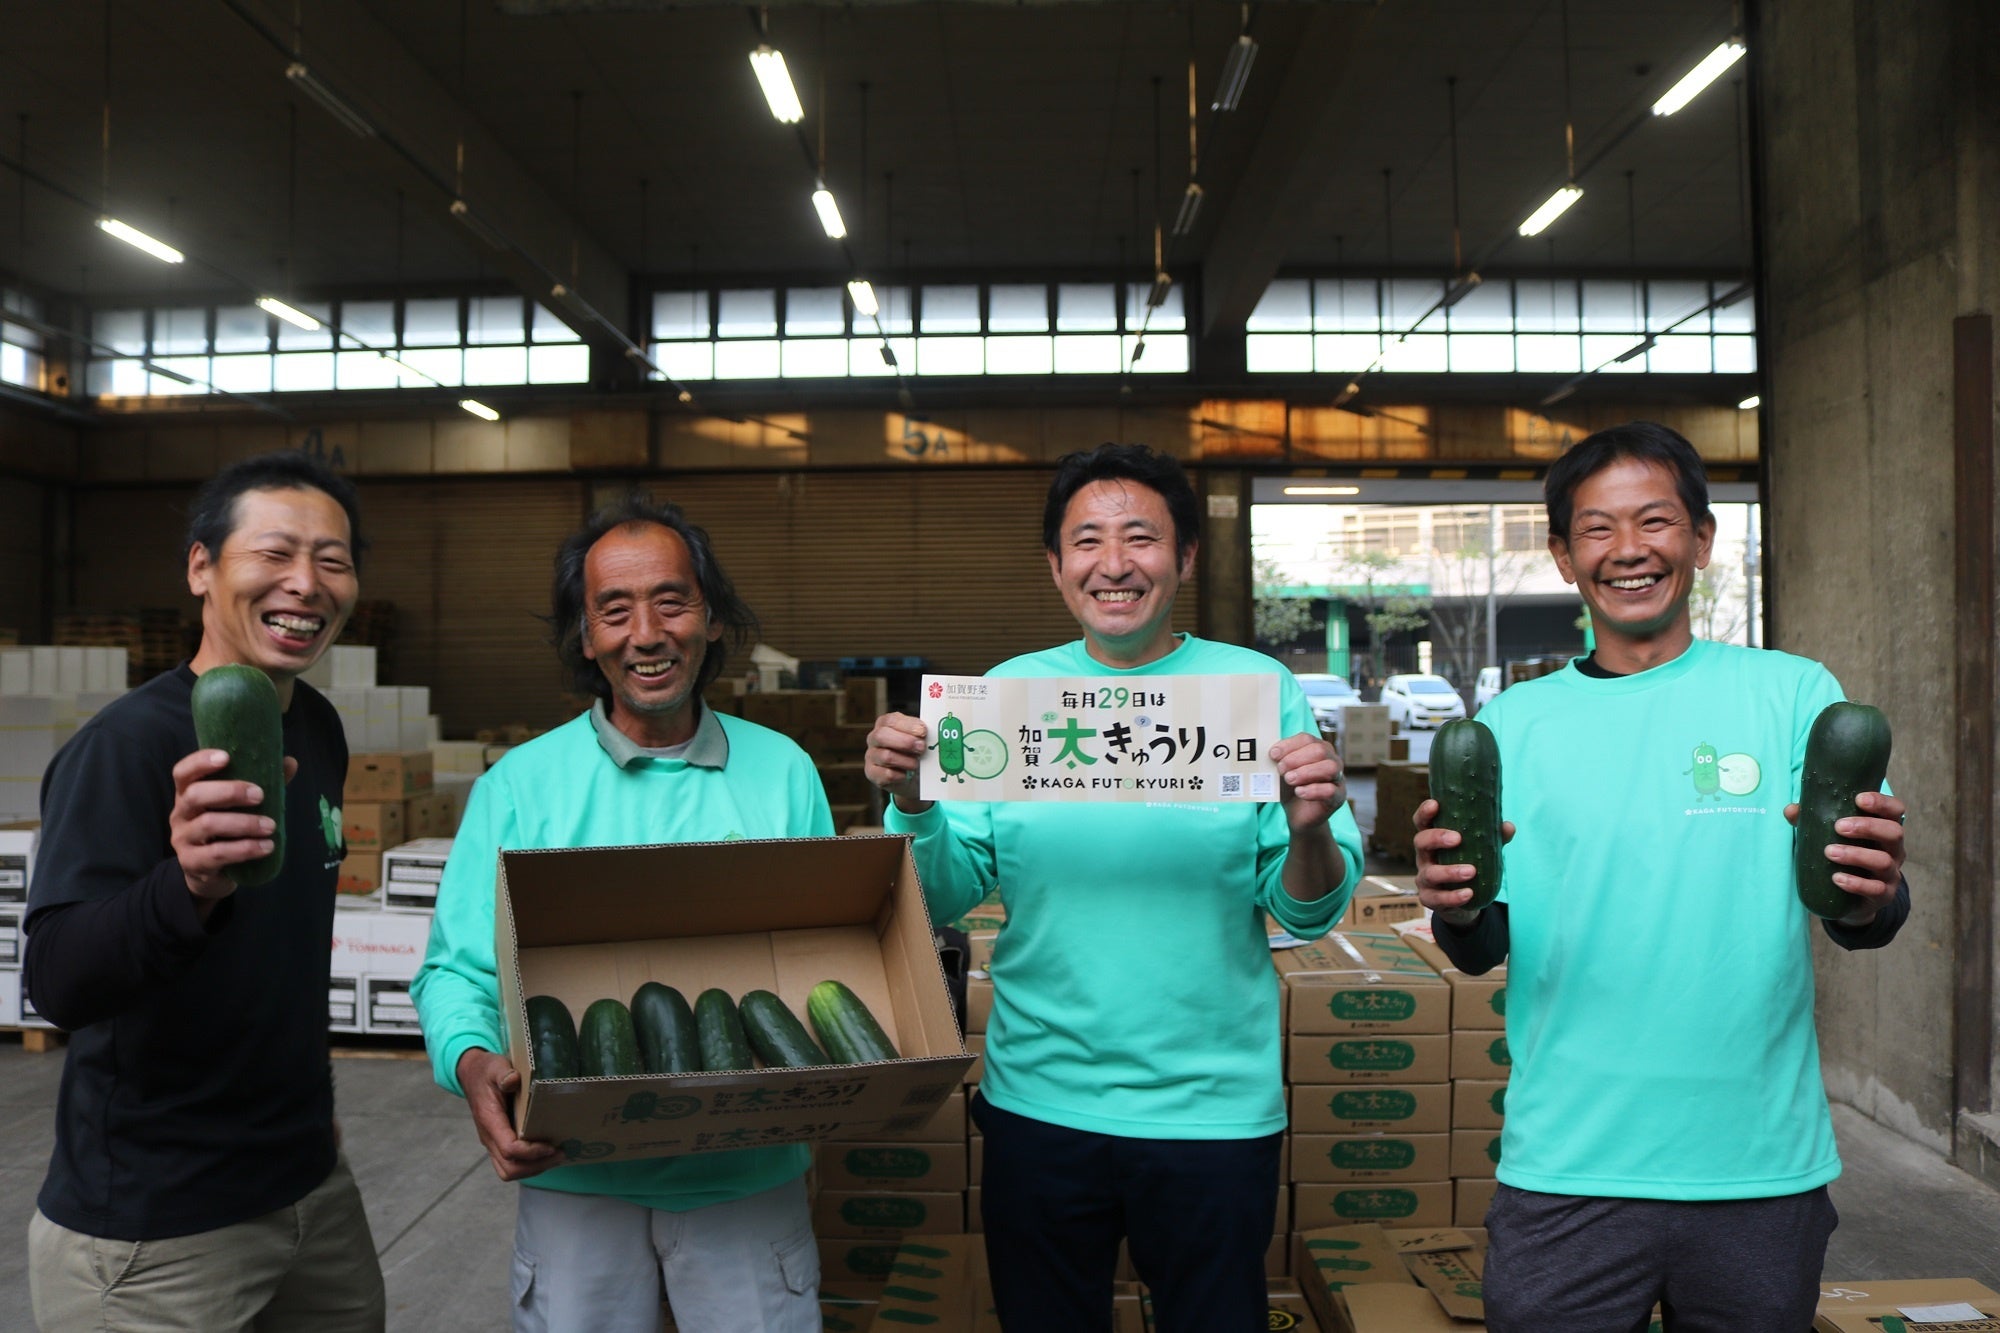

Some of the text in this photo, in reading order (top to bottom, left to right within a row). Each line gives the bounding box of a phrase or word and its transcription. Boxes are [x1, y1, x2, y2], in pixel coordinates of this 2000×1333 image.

[947, 684, 988, 696] 加賀野菜
[1061, 687, 1166, 709] 毎月29日は
[1040, 777, 1085, 789] KAGA
